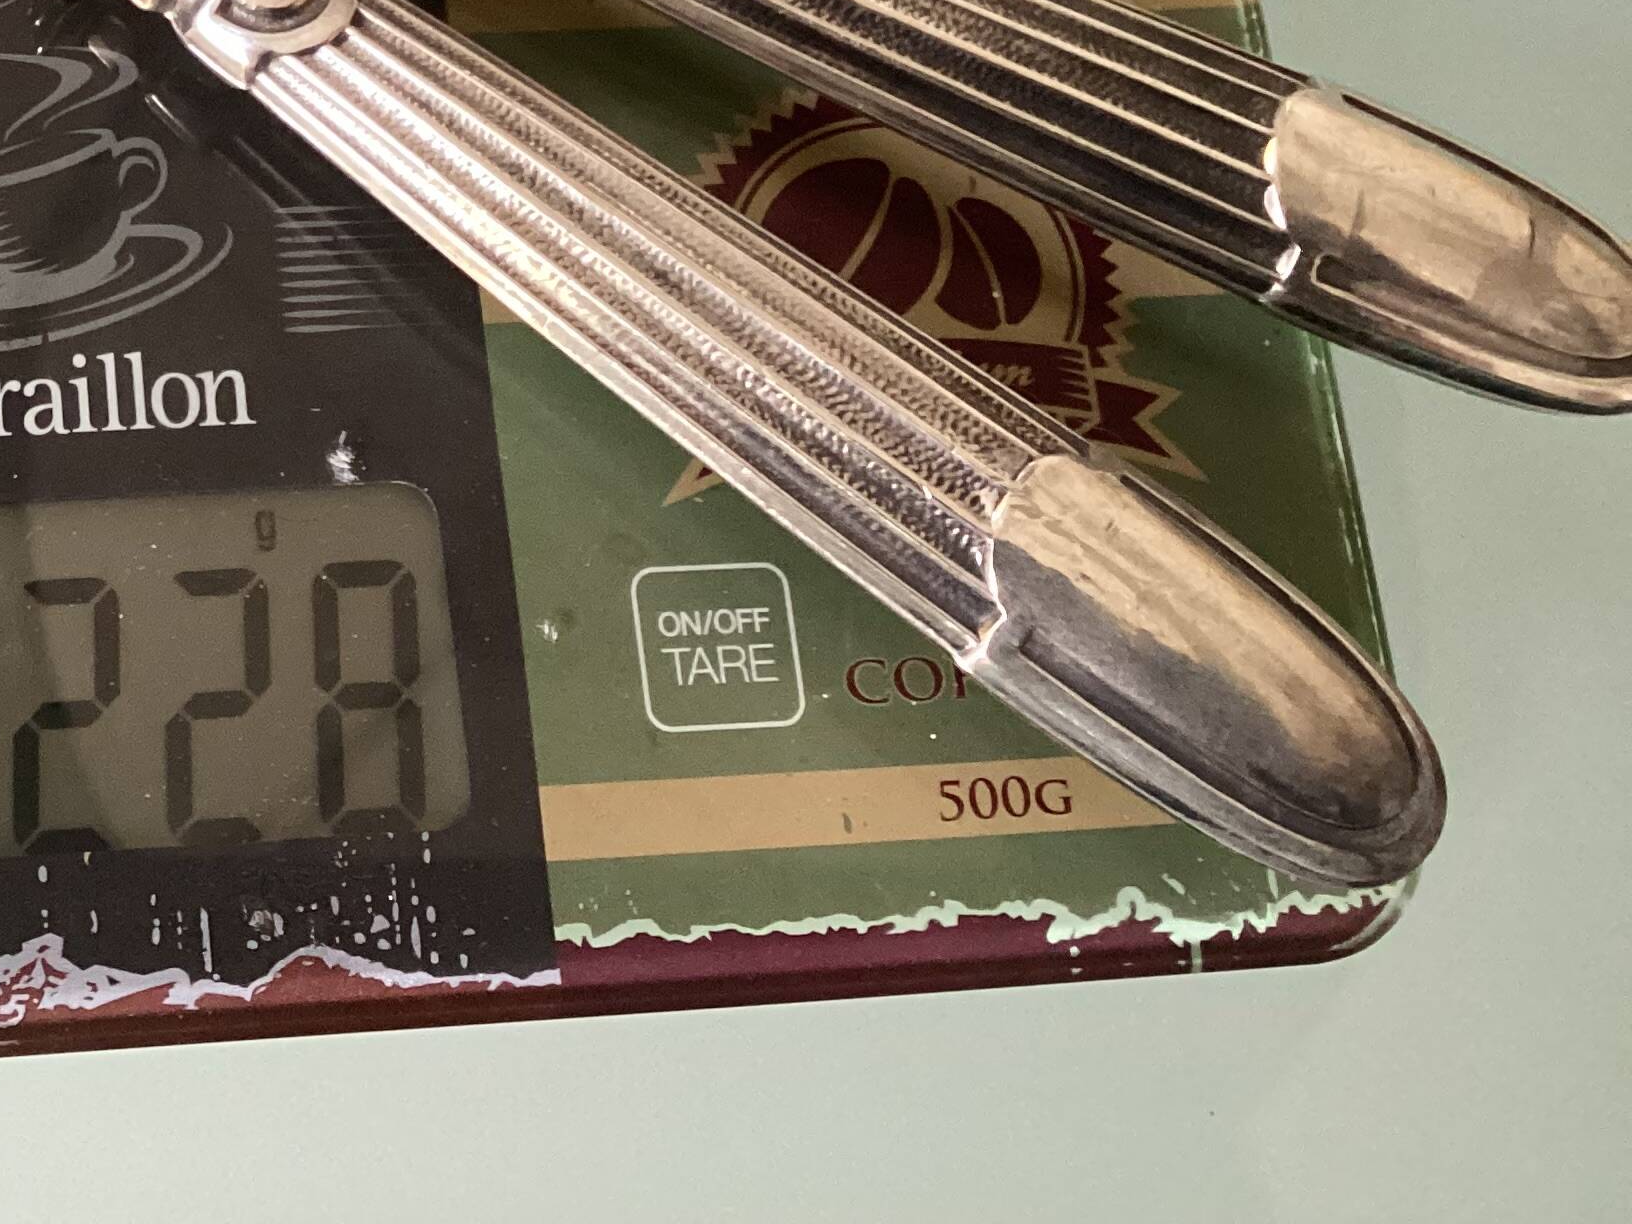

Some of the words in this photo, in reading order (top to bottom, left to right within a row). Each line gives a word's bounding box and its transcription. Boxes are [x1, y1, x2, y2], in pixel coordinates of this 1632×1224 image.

[254, 509, 278, 552] g
[657, 606, 771, 638] ON/OFF
[659, 642, 780, 687] TARE
[12, 559, 428, 855] 228
[939, 775, 1073, 822] 500G
